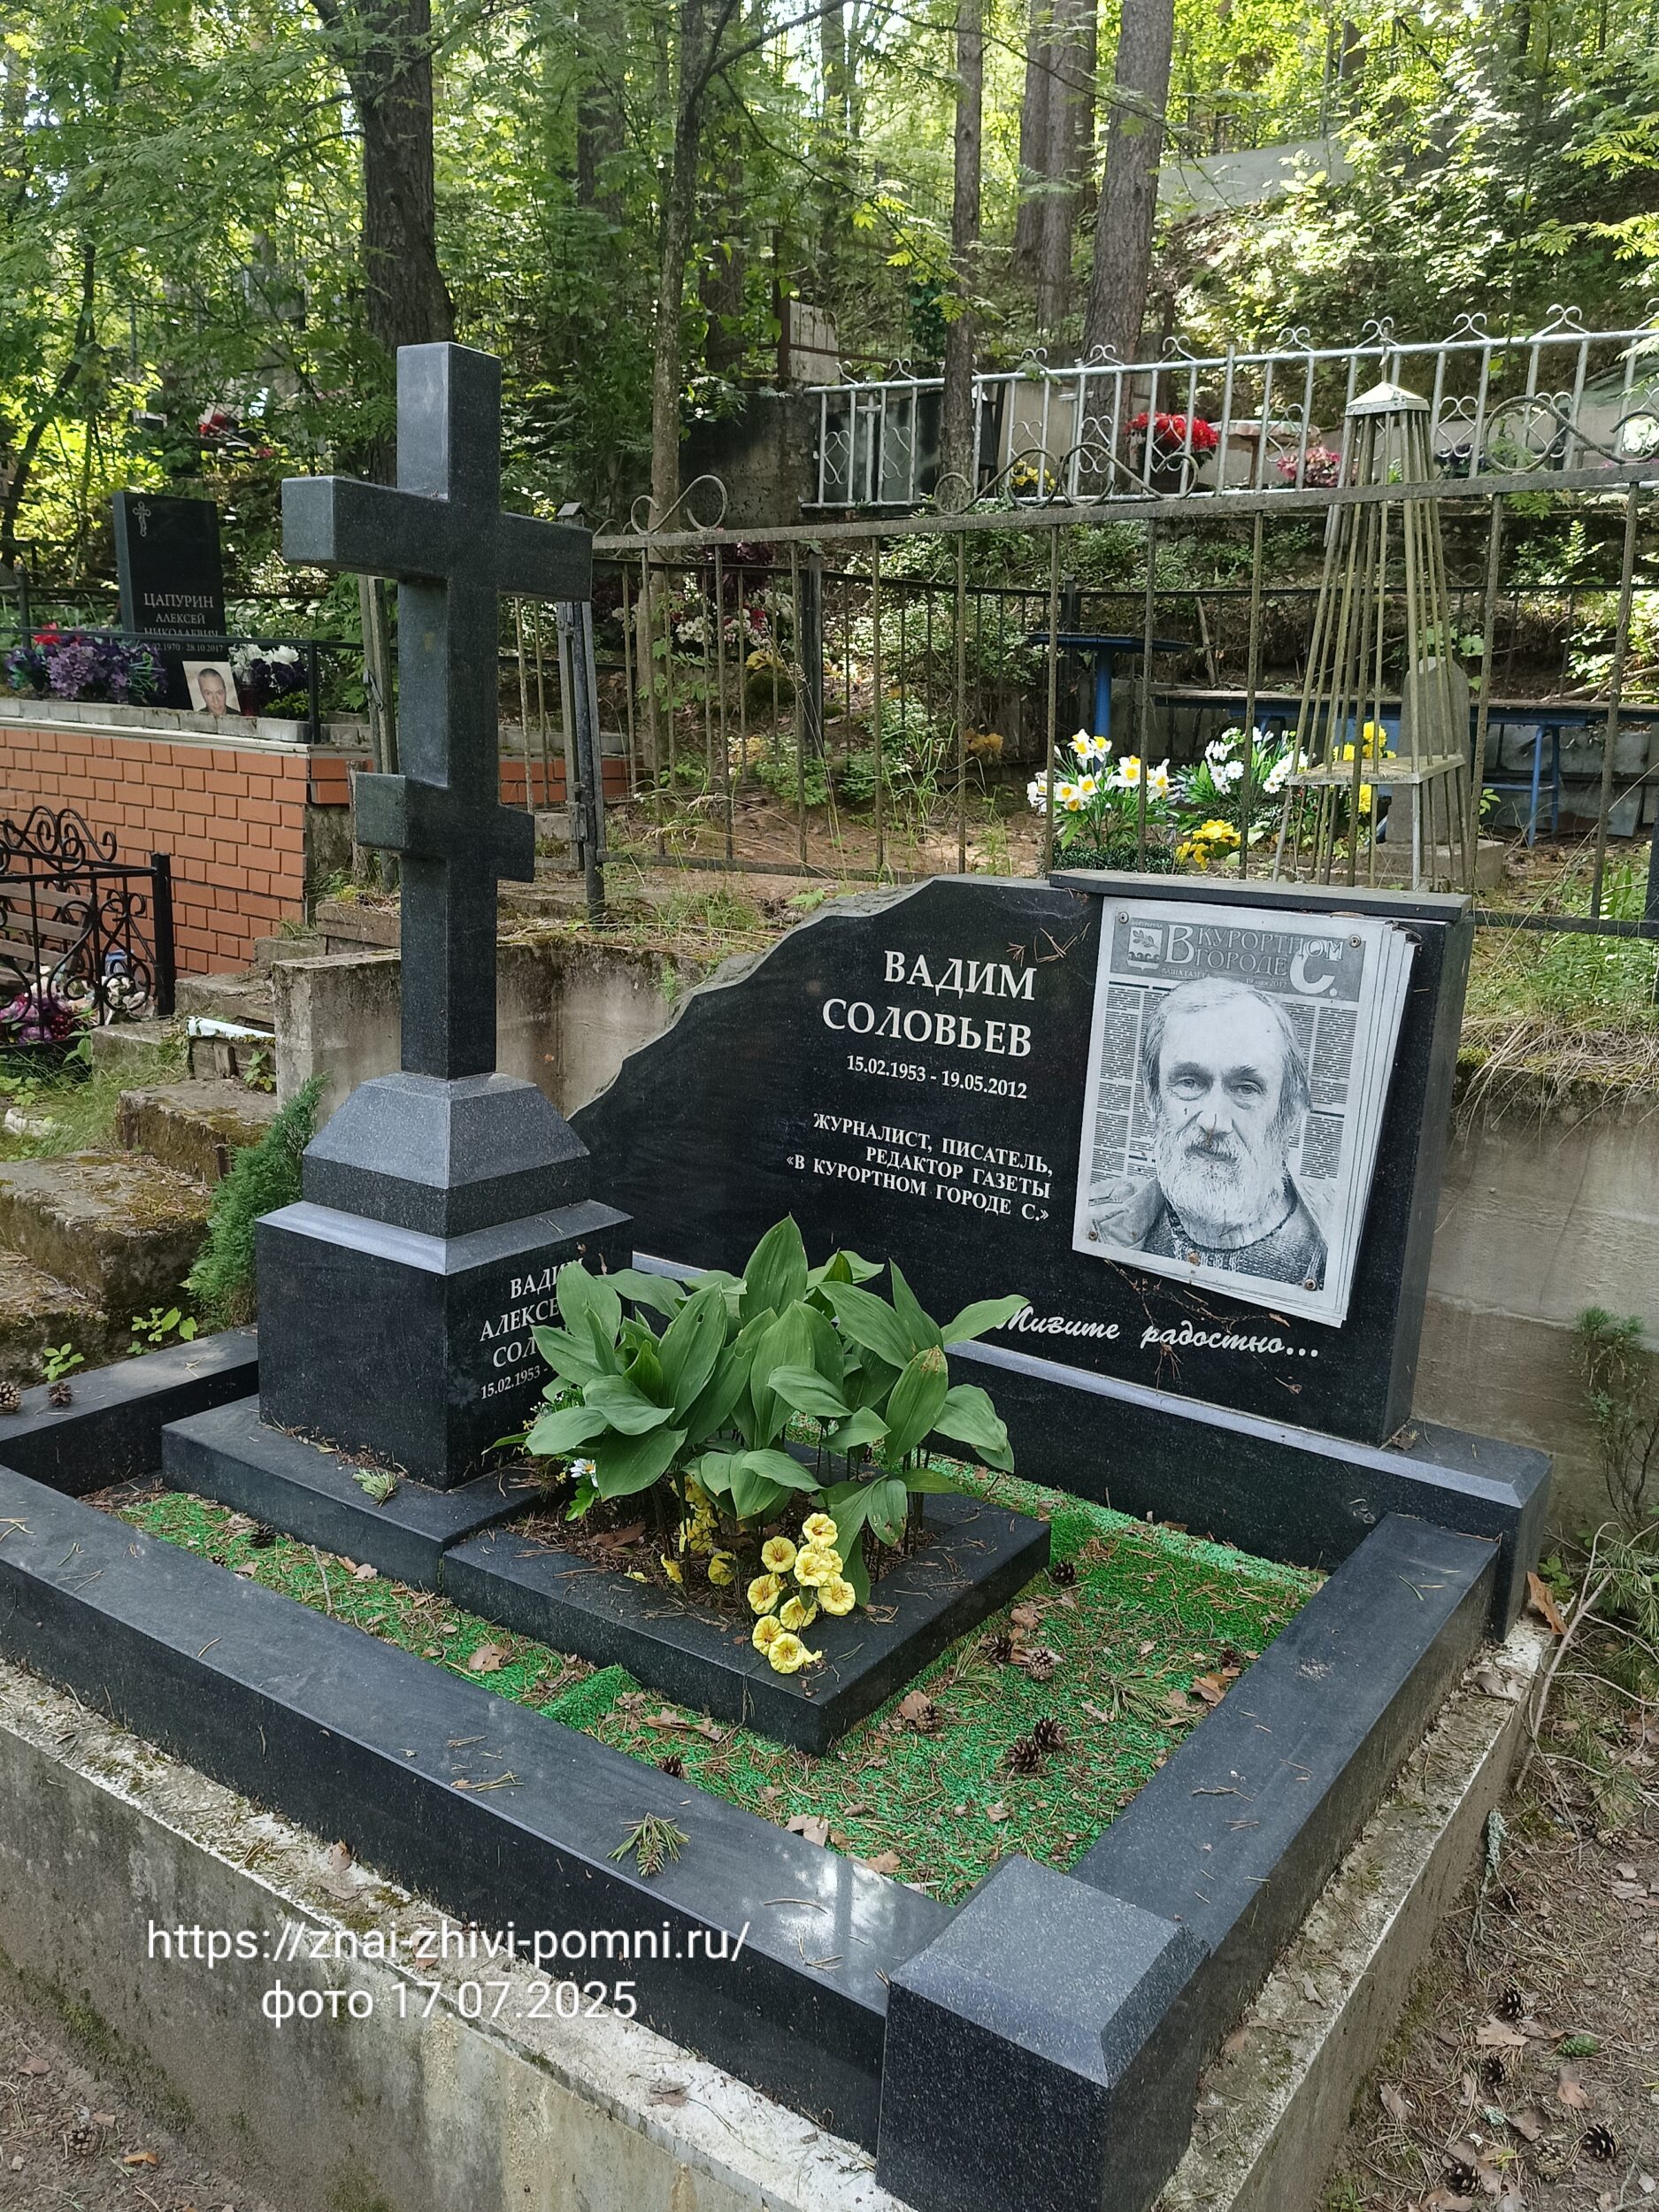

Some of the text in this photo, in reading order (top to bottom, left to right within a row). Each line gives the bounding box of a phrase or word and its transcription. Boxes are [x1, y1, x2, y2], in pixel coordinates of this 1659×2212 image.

[143, 593, 214, 609] ЦАПУРИН
[156, 612, 206, 625] АЛЕКСЕЙ
[186, 643, 224, 652] 28.10.2017
[1164, 924, 1344, 964] В КУРОРТНОМ
[1195, 948, 1288, 977] ГОРОДЕ
[884, 950, 1038, 1001] ВАДИМ
[822, 998, 1033, 1057] СОЛОВЬЕВ
[847, 1055, 926, 1082] 15.02.1953
[941, 1071, 1028, 1099] 19.05.2012
[813, 1112, 1054, 1177] ЖУРНАЛИСТ, ПИСАТЕЛЬ,
[786, 1154, 1049, 1221] «В КУРОРТНОМ ГОРОДЕ С.»
[865, 1147, 1051, 1199] РЕДАКТОР ГАЗЕТЫ
[510, 1258, 584, 1299] ВАДИ
[480, 1297, 559, 1341] АЛЕКСЕ
[1140, 1319, 1320, 1358] радостно...
[480, 1365, 541, 1400] 15.02.1953
